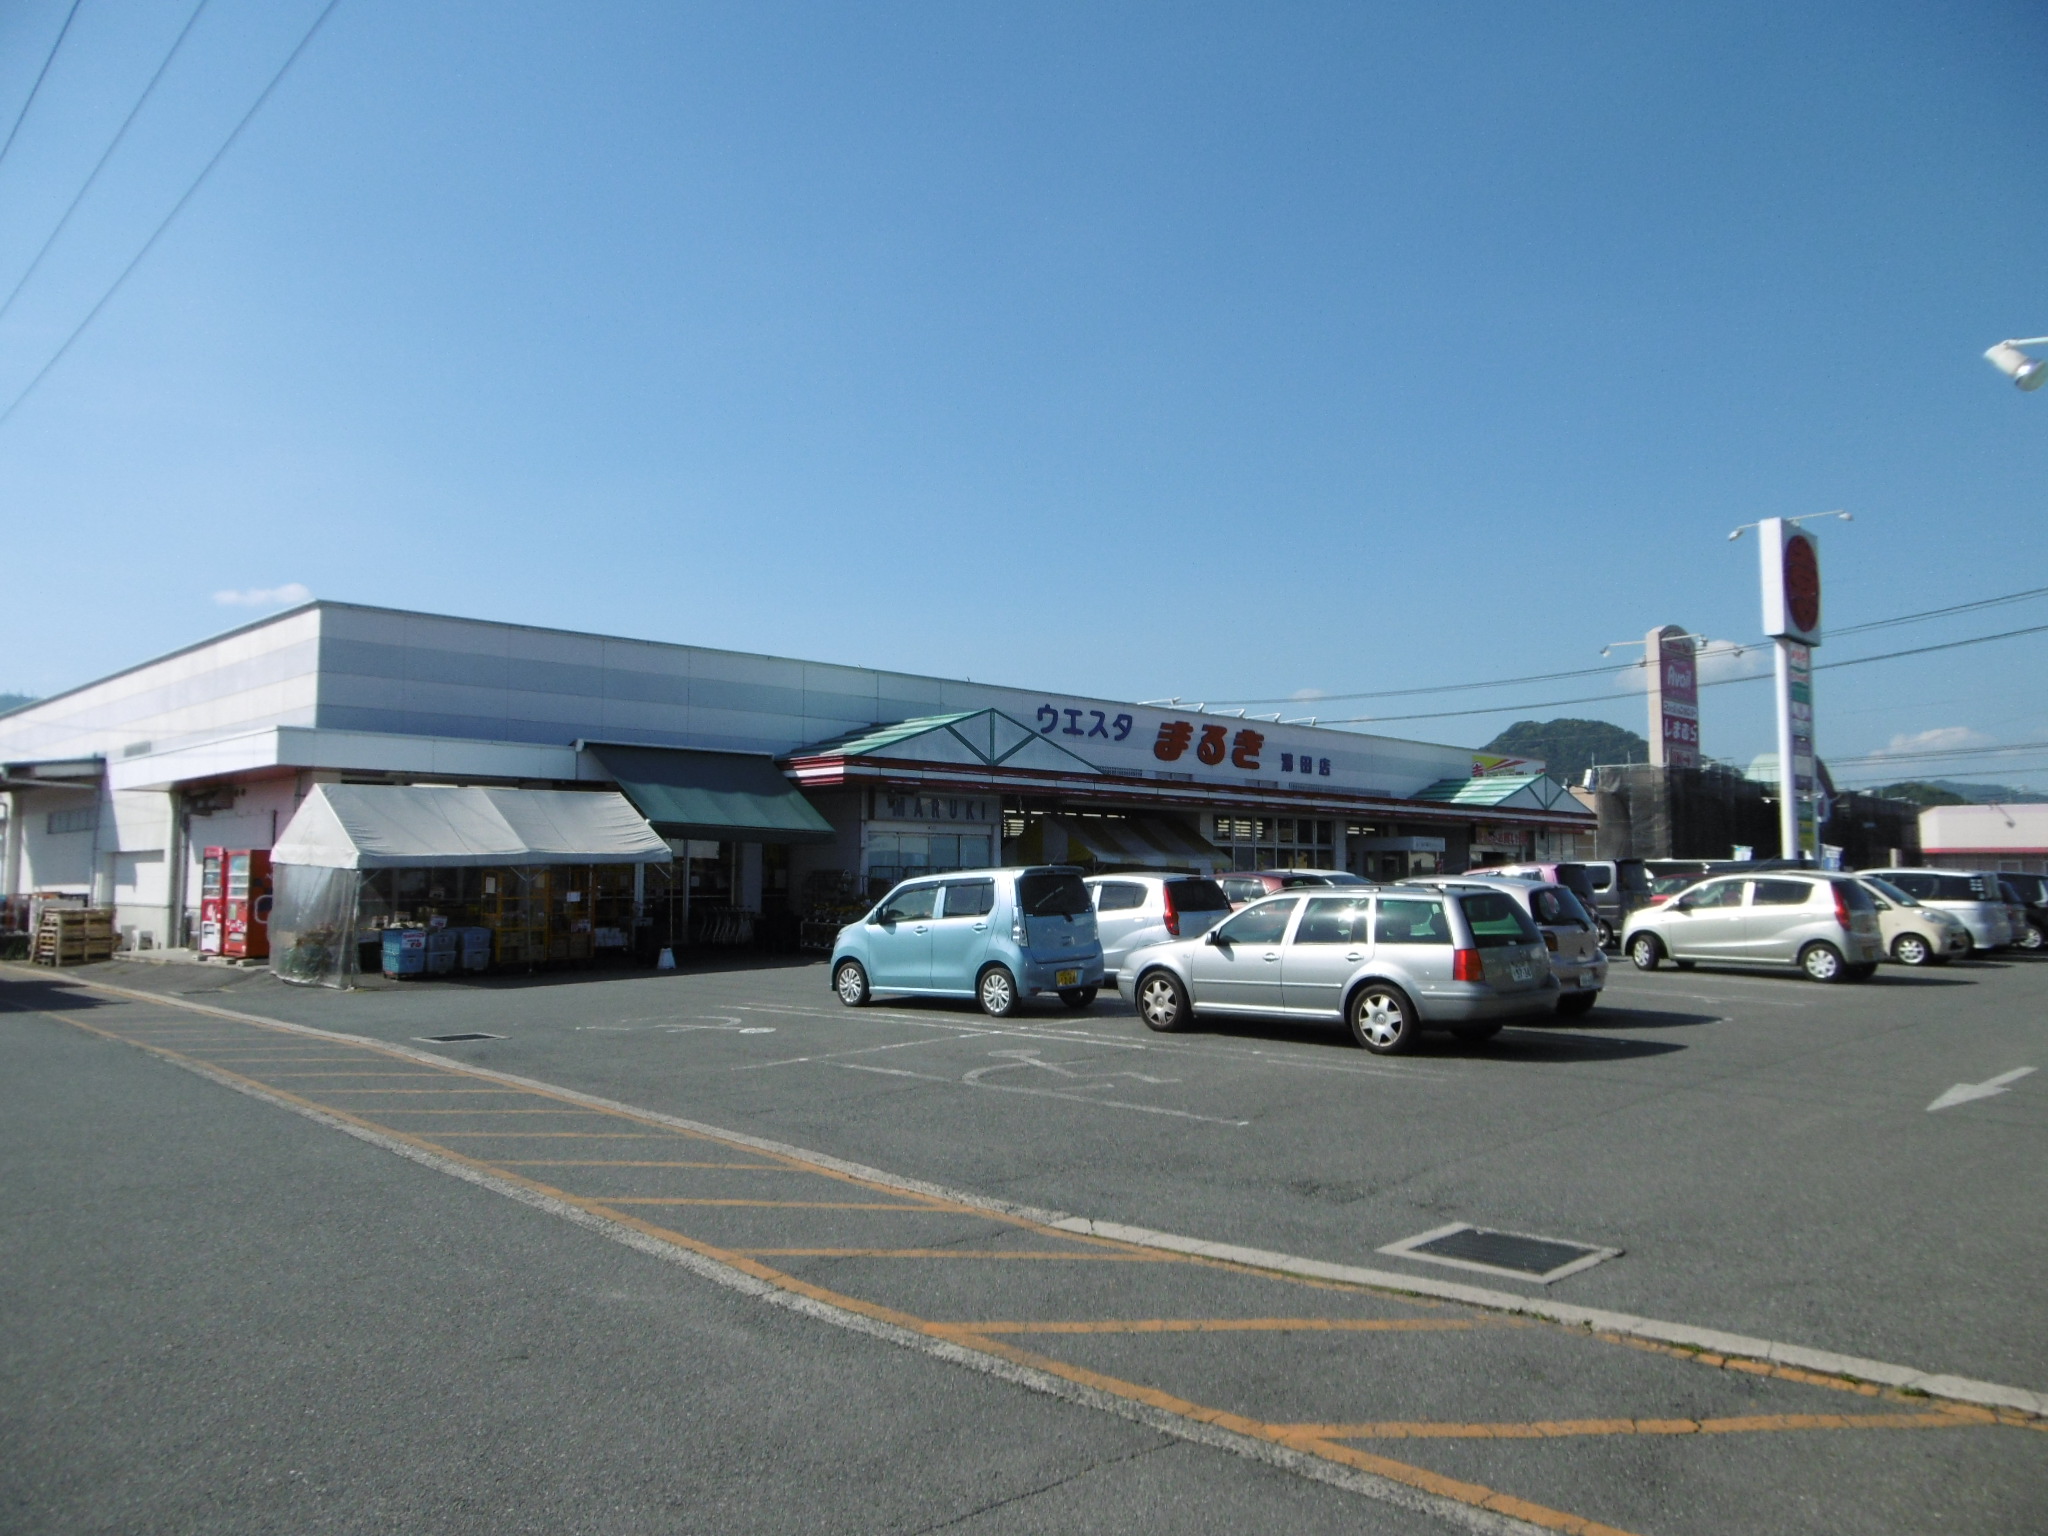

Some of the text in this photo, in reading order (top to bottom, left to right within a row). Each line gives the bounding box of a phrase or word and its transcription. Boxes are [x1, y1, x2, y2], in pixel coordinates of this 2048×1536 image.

[1037, 704, 1134, 743] ウエスタ
[1153, 719, 1266, 770] まるき
[1664, 718, 1697, 742] しまむら
[891, 796, 986, 820] MARUKI
